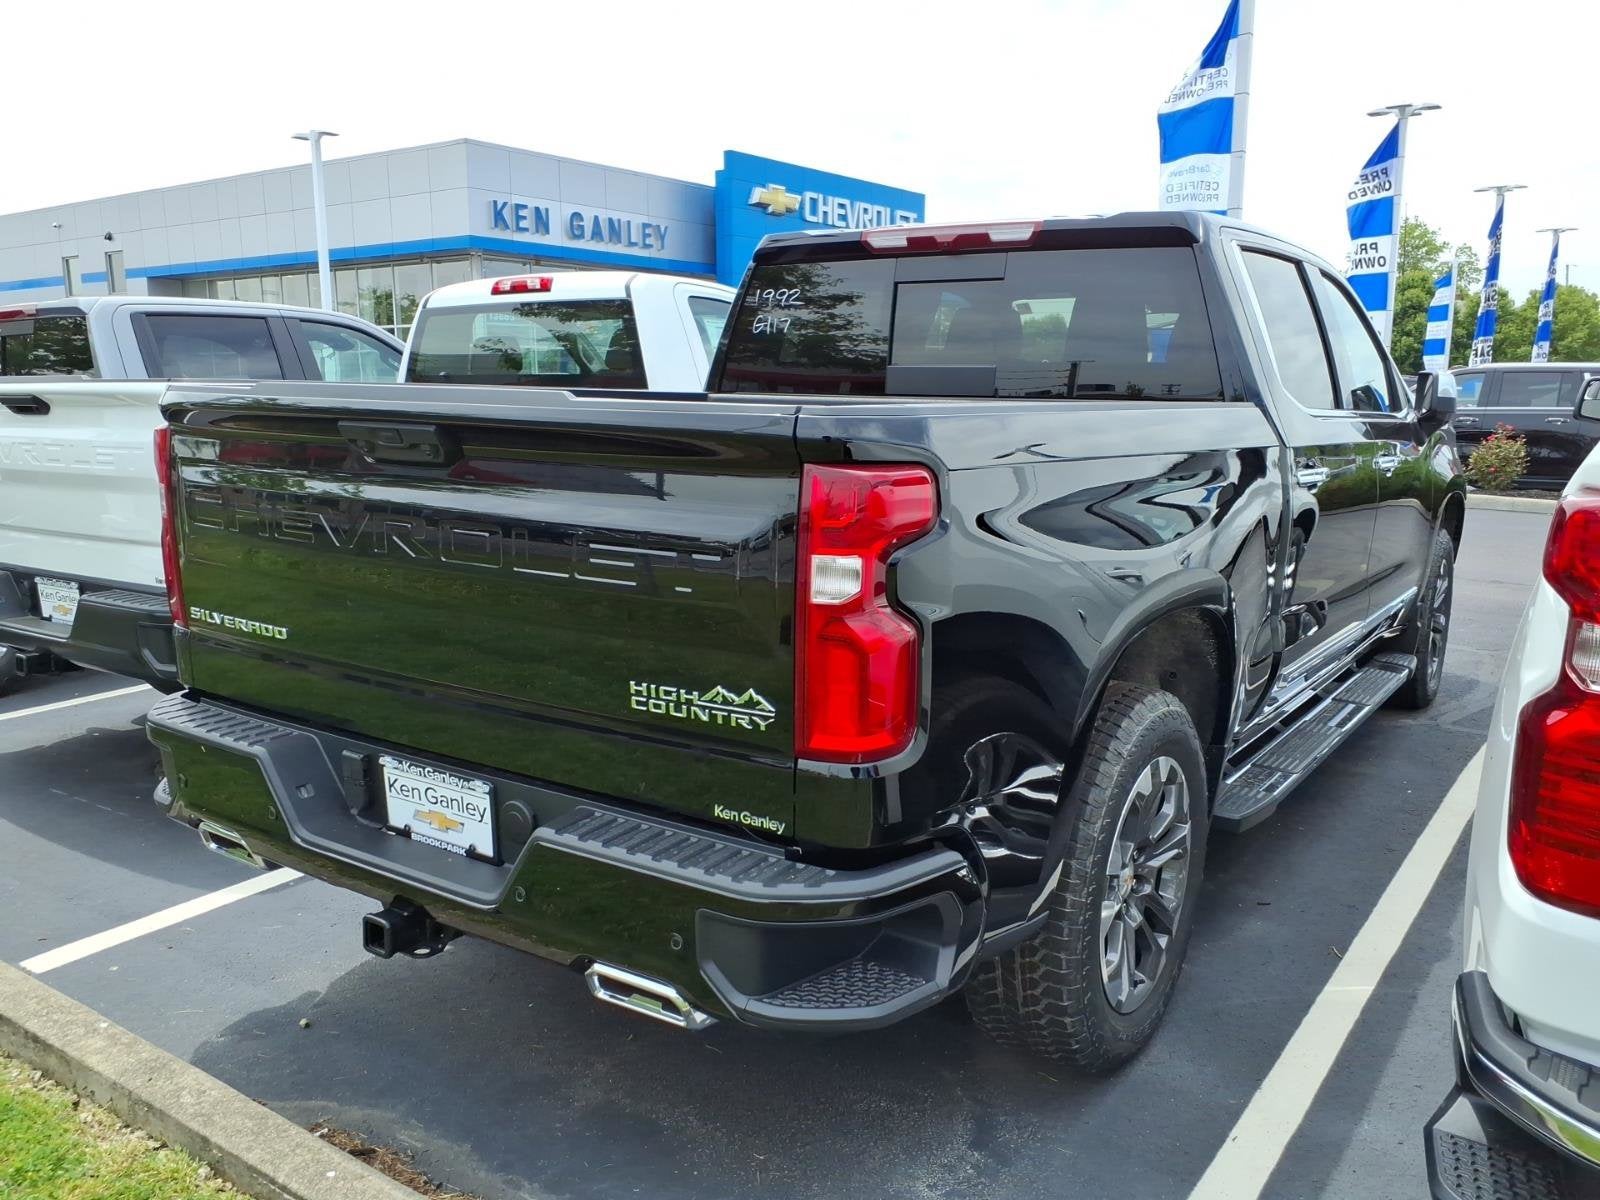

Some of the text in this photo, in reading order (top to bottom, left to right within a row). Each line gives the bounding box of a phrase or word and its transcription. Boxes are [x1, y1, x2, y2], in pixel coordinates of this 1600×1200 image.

[490, 199, 668, 251] KEN GANLEY
[189, 606, 288, 640] SILVERADO
[629, 680, 699, 704] HIGH
[630, 695, 776, 731] COUNTRY
[402, 761, 424, 776] Ken
[424, 767, 464, 791] Ganley
[387, 776, 488, 823] Ken Ganley
[714, 804, 786, 835] Ken Ganley
